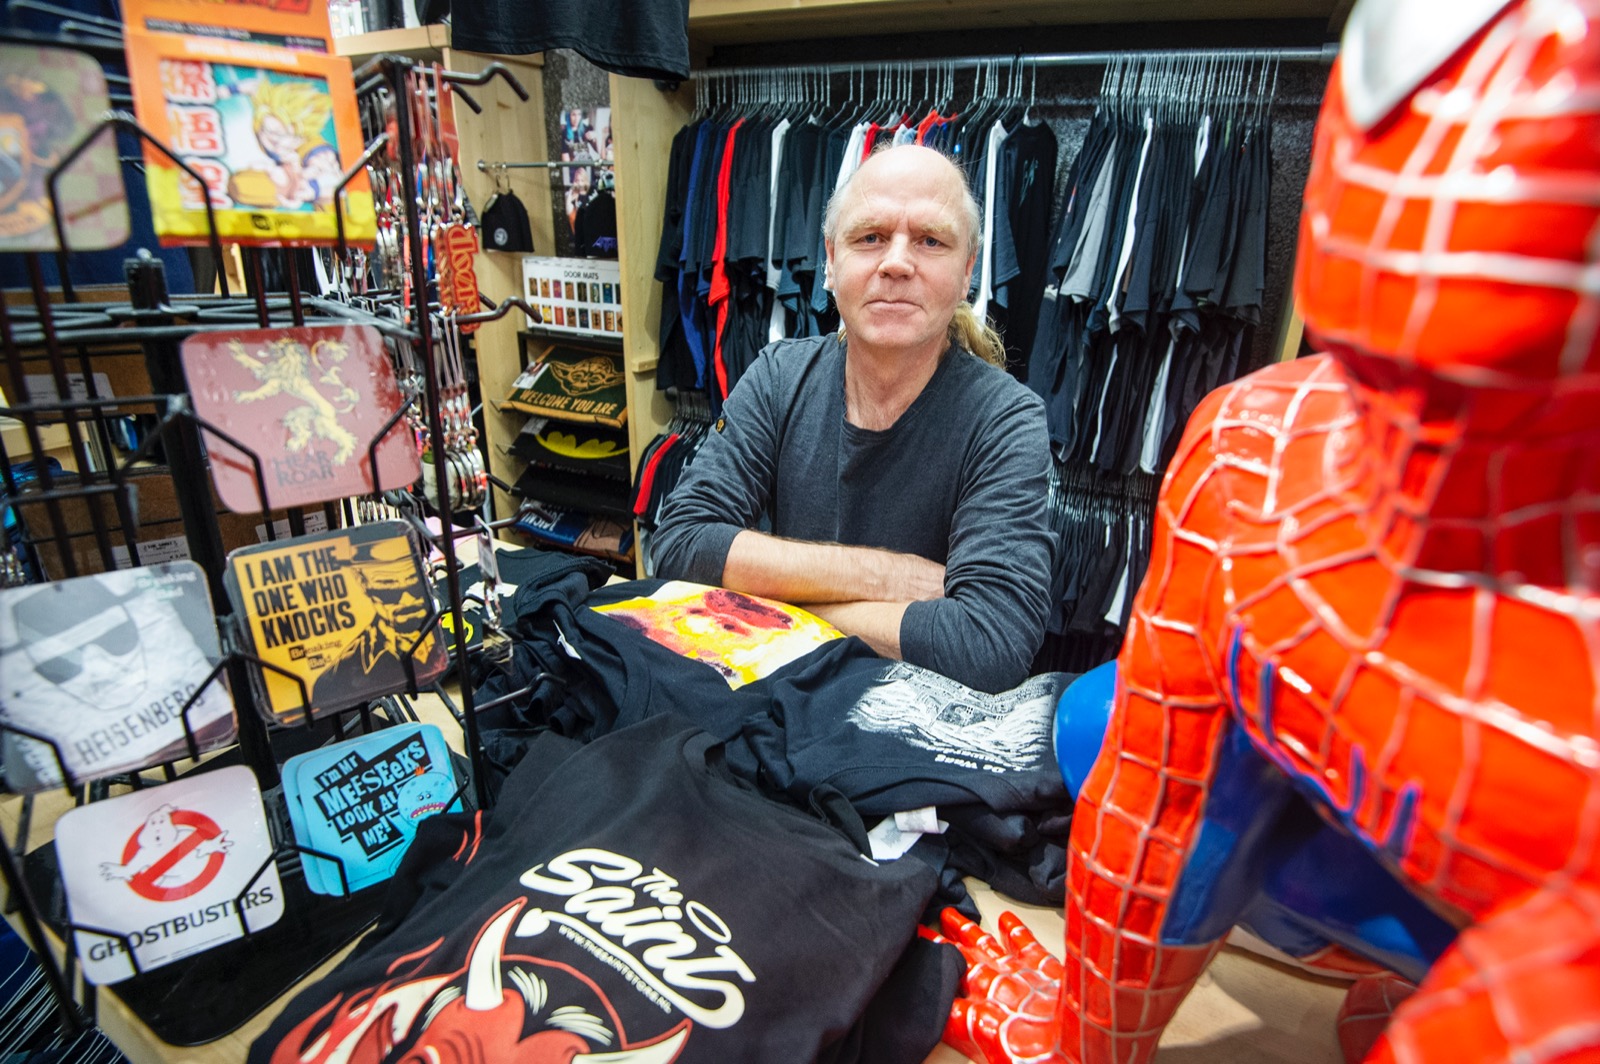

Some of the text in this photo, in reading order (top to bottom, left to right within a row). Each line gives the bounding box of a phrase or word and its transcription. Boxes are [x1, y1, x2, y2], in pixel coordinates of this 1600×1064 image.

[564, 270, 599, 280] DOOR MATS
[519, 389, 618, 415] WELCOME YOU ARE
[244, 545, 341, 590] I AM THE
[253, 573, 348, 618] ONE WHO
[260, 600, 356, 650] KNOCKS
[73, 682, 205, 766] HEISENBERG
[319, 754, 359, 789] I'm Mr
[334, 800, 380, 831] LOOK
[361, 815, 392, 848] ME!
[631, 866, 685, 906] The
[88, 886, 274, 962] GHOSTBUSTRS
[518, 847, 757, 1028] Saint
